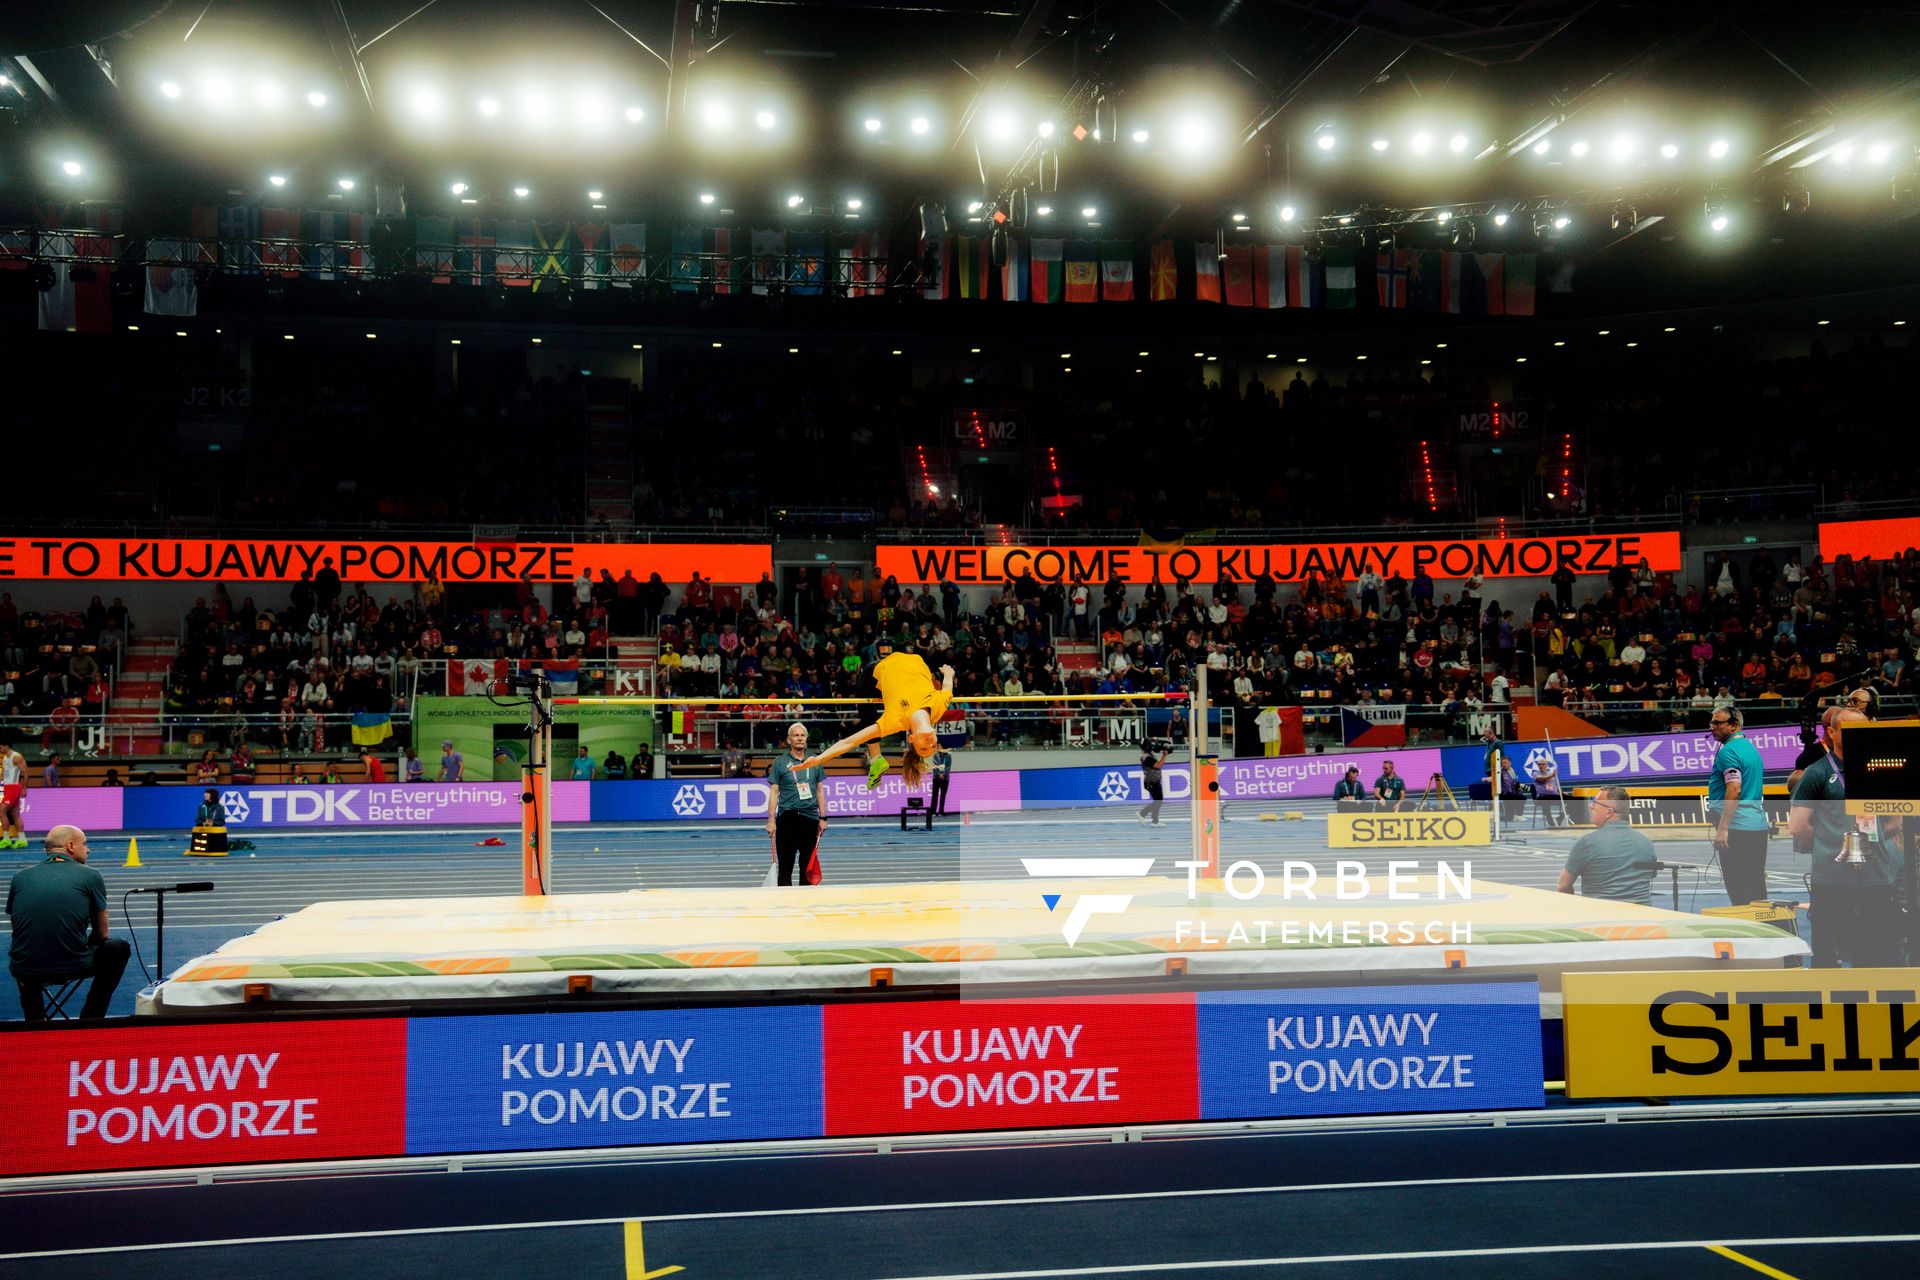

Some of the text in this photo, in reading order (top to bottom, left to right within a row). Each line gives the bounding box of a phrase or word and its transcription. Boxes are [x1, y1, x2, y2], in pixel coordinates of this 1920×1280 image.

[987, 420, 1017, 440] M2
[1459, 412, 1491, 432] M2
[31, 541, 100, 577] TO
[119, 542, 325, 578] KUJAWY
[340, 544, 574, 580] POMORZE
[911, 536, 1642, 582] WELCOME TO KUJAWY POMORZE
[615, 669, 645, 692] K1
[78, 726, 105, 750] J1
[954, 721, 962, 733] 4
[1066, 719, 1090, 741] L1
[1110, 718, 1140, 740] M1
[1555, 740, 1667, 777] TDK
[1671, 739, 1690, 754] In
[1234, 765, 1250, 780] In
[369, 787, 507, 806] In Everything,
[704, 783, 779, 815] TD
[1235, 779, 1296, 795] Better
[249, 789, 362, 822] TDK
[368, 806, 435, 821] Better
[827, 798, 876, 812] etter
[1863, 802, 1914, 814] SEIKO
[1351, 818, 1468, 844] SEIKO
[1755, 911, 1777, 921] SEIKO
[1266, 1012, 1439, 1051] KUJAWY
[902, 1024, 1083, 1065] KUJAWY
[502, 1037, 696, 1080] KUJAWY
[67, 1052, 281, 1098] KUJAWY
[1268, 1053, 1475, 1095] POMORZE
[903, 1066, 1120, 1110] POMORZE
[501, 1082, 732, 1127] POMORZE
[66, 1097, 319, 1147] POMORZE
